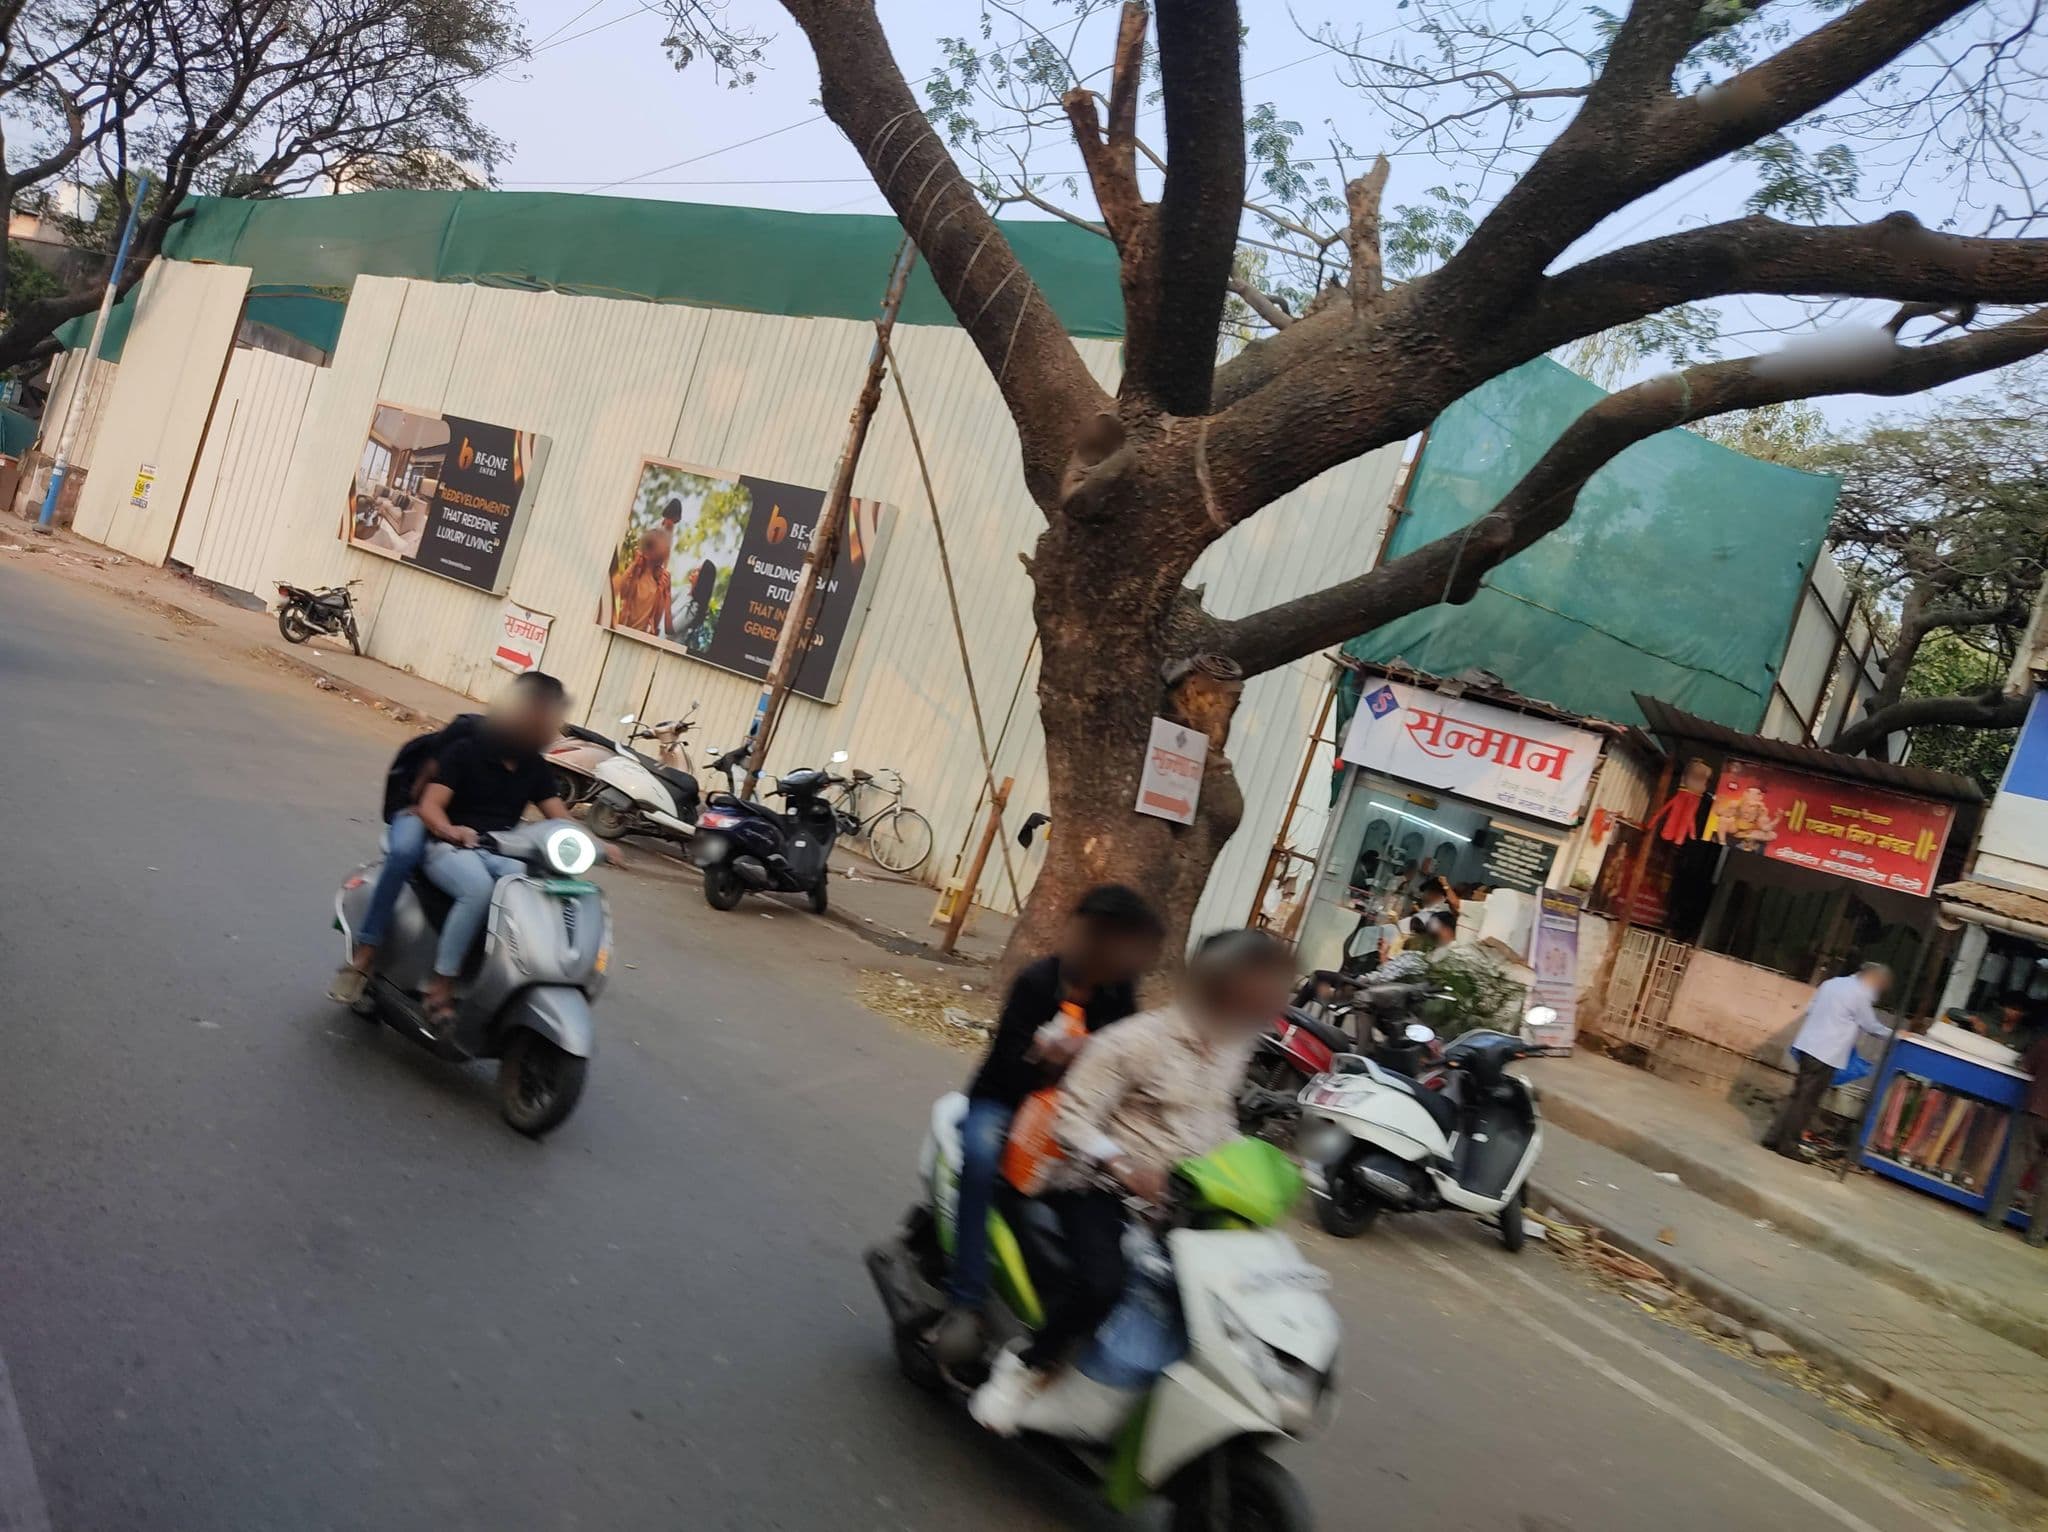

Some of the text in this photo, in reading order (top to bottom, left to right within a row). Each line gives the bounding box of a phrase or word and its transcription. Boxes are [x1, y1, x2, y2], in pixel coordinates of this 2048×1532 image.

[474, 451, 508, 471] BE-ONE
[442, 507, 499, 535] THAT REDEFINE
[436, 525, 467, 544] LUXURY
[748, 600, 774, 619] THAT
[505, 614, 549, 644] सन्मान
[1406, 707, 1574, 780] सन्मान
